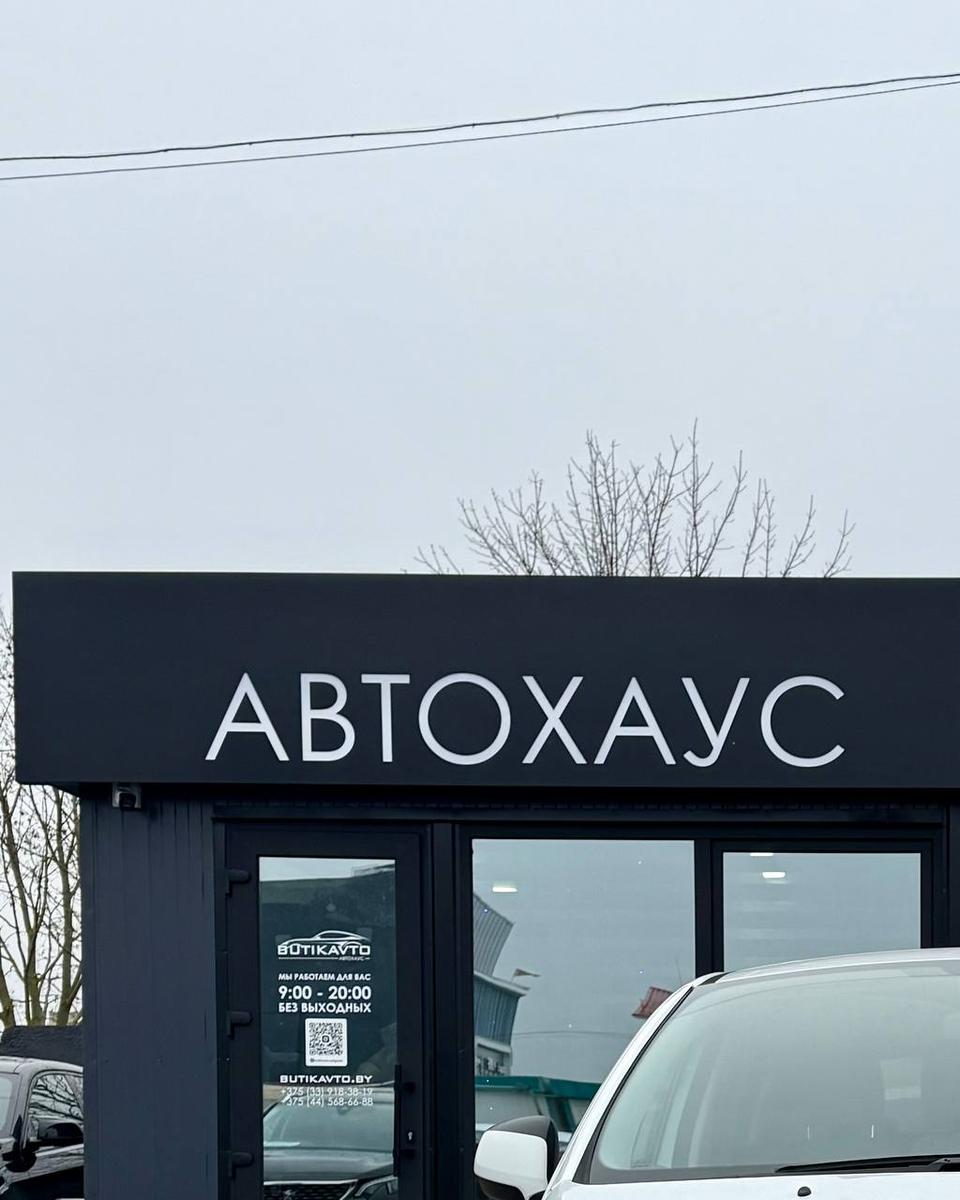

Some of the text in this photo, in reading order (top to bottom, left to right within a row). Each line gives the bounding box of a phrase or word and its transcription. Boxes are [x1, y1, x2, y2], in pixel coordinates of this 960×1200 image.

[205, 672, 845, 768] АВТОХАУС
[277, 944, 371, 956] BUTIKAVTO
[278, 973, 371, 981] МЫ РАБОТАЕМ ДЛЯ ВАС
[278, 985, 312, 1000] 9:00
[328, 985, 372, 1000] 20:00
[278, 1002, 372, 1014] БЕЗ ВЫХОДНЫХ
[280, 1075, 373, 1084] BUTIKAVTO.BY
[281, 1086, 373, 1098] +375 (33) 918-38-19
[306, 1097, 325, 1108] (44)
[327, 1097, 374, 1107] 568-66-88
